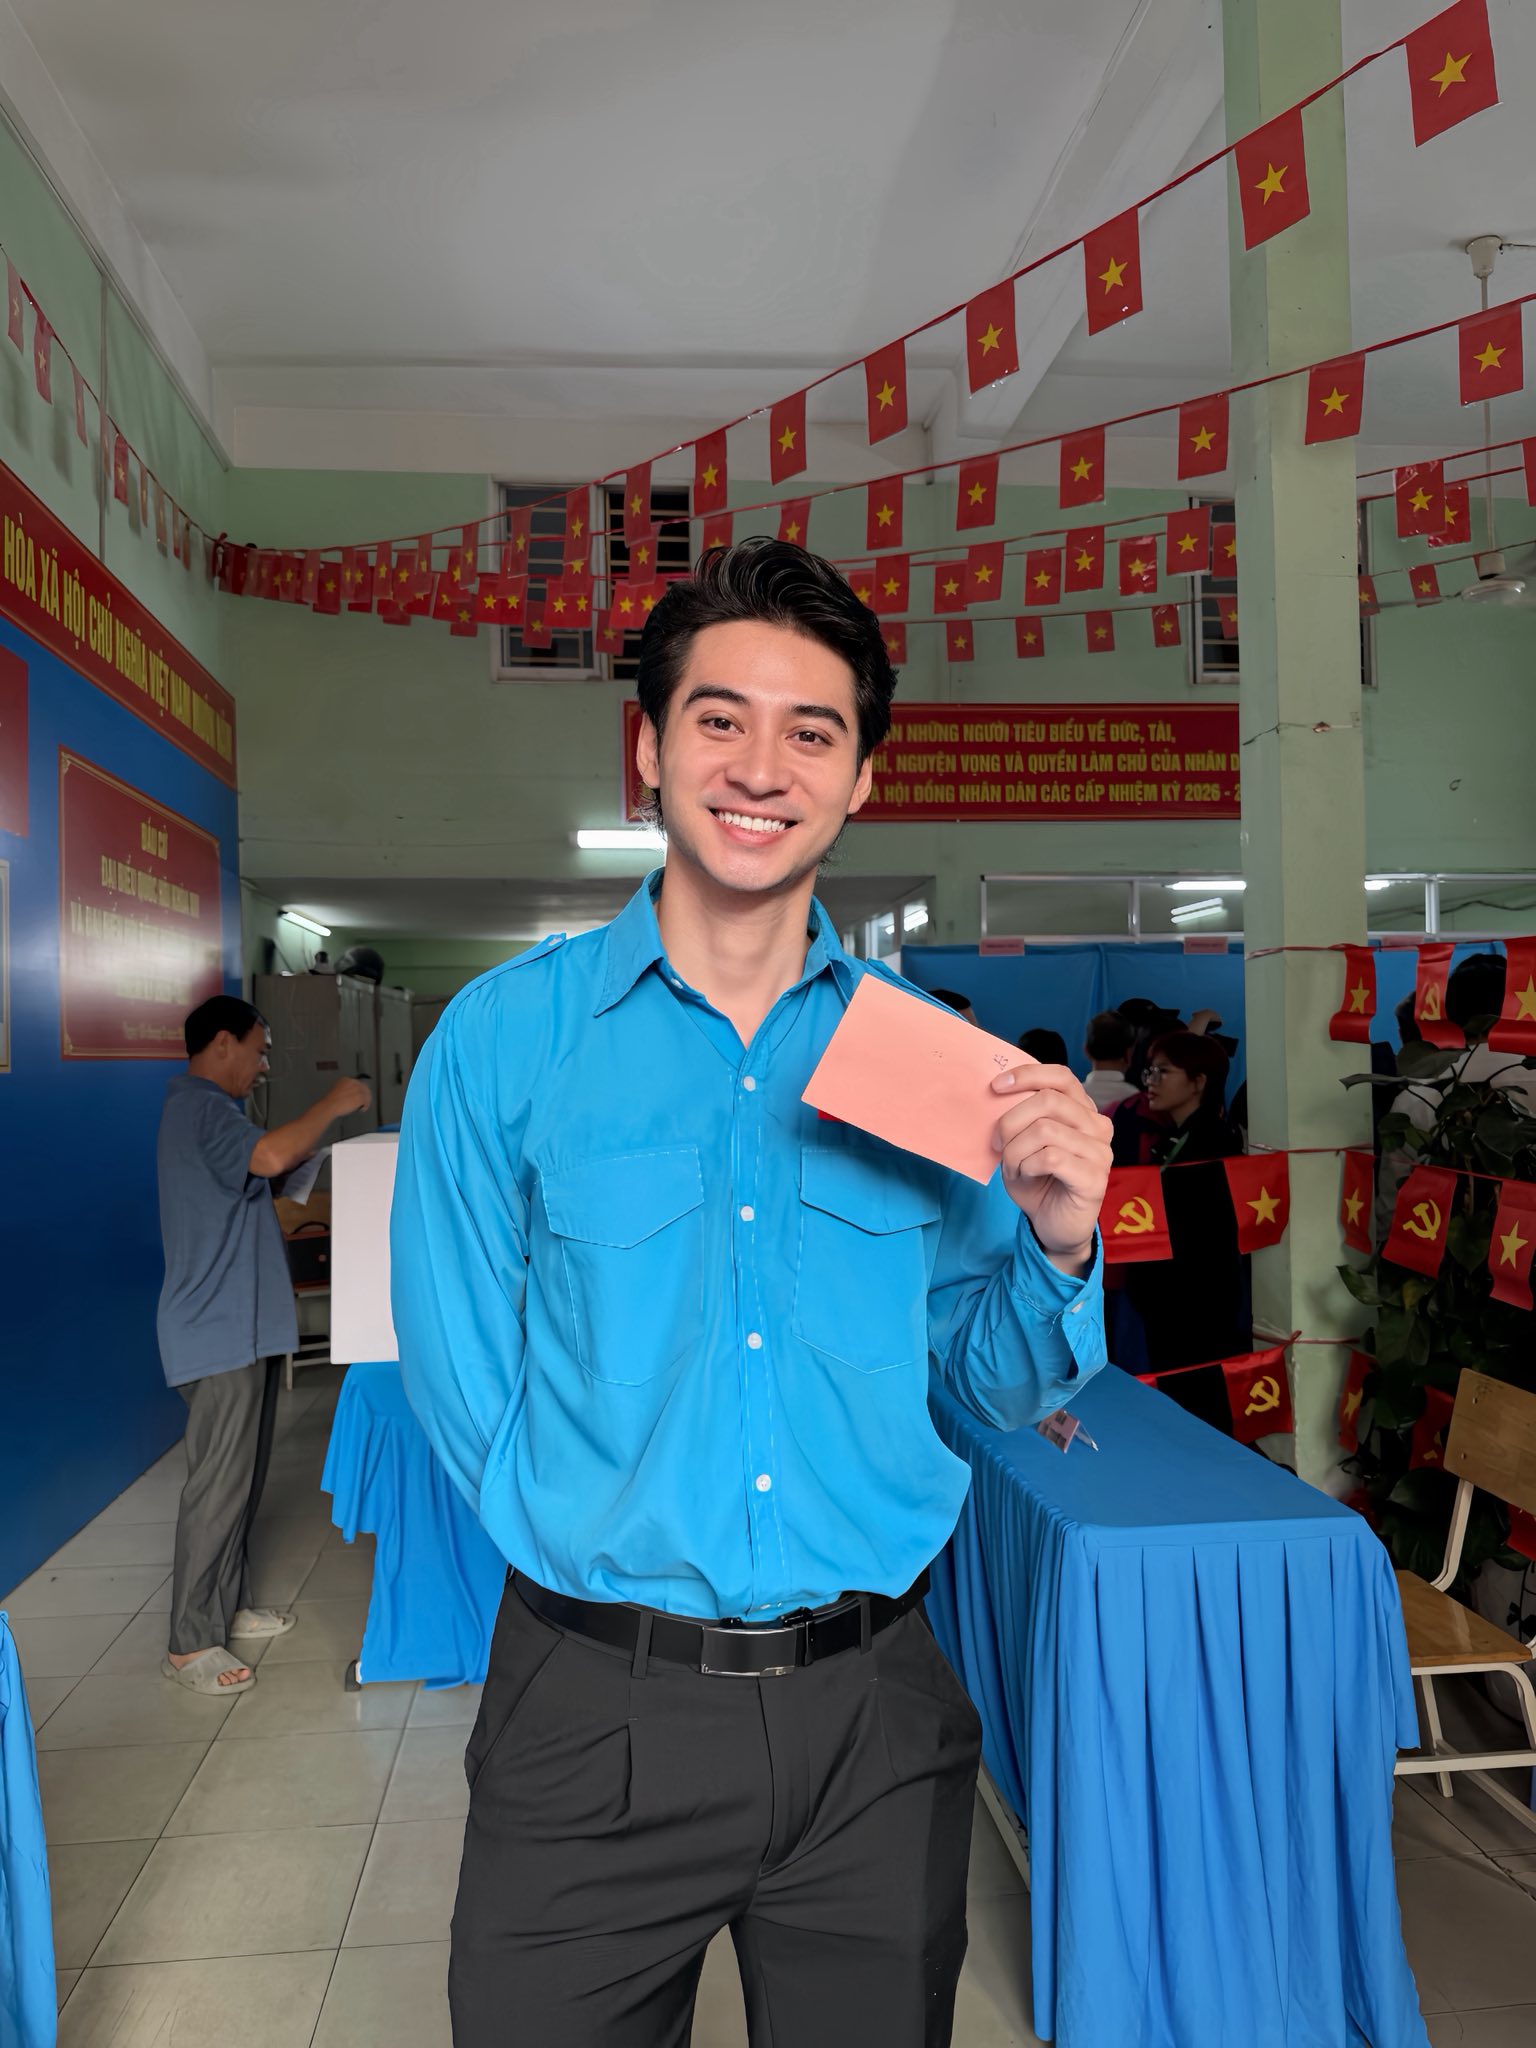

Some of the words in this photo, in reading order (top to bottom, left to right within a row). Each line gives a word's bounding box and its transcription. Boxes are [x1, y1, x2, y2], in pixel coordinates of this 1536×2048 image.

[4, 512, 37, 602] HÒA
[40, 548, 60, 622] XÃ
[63, 568, 86, 650] HỘI
[89, 592, 112, 664] CHỦ
[115, 617, 148, 694] NGHĨA
[149, 649, 169, 717] VIỆT
[906, 720, 960, 742] NHỮNG
[963, 720, 1009, 742] NGƯỜI
[1013, 720, 1046, 742] TIÊU
[1049, 717, 1085, 742] BIỂU
[1087, 719, 1106, 742] VỀ
[1147, 720, 1176, 743] TÀI,
[896, 750, 957, 776] NGUYỆN
[960, 753, 1000, 776] VỌNG
[1004, 751, 1025, 772] VÀ
[1028, 749, 1077, 775] QUYỀN
[1080, 751, 1114, 772] LÀM
[1117, 748, 1148, 772] CHỦ
[1151, 748, 1181, 772] CỦA
[1184, 750, 1227, 772] NHÂN
[883, 781, 909, 807] HỘI
[913, 779, 955, 803] ĐỒNG
[959, 781, 1001, 803] NHÂN
[1005, 781, 1037, 802] DÂN
[1040, 780, 1071, 802] CÁC
[1075, 778, 1105, 802] CẤP
[1108, 780, 1158, 806] NHIỆM
[1161, 780, 1181, 802] KỲ
[1184, 783, 1221, 802] 2026
